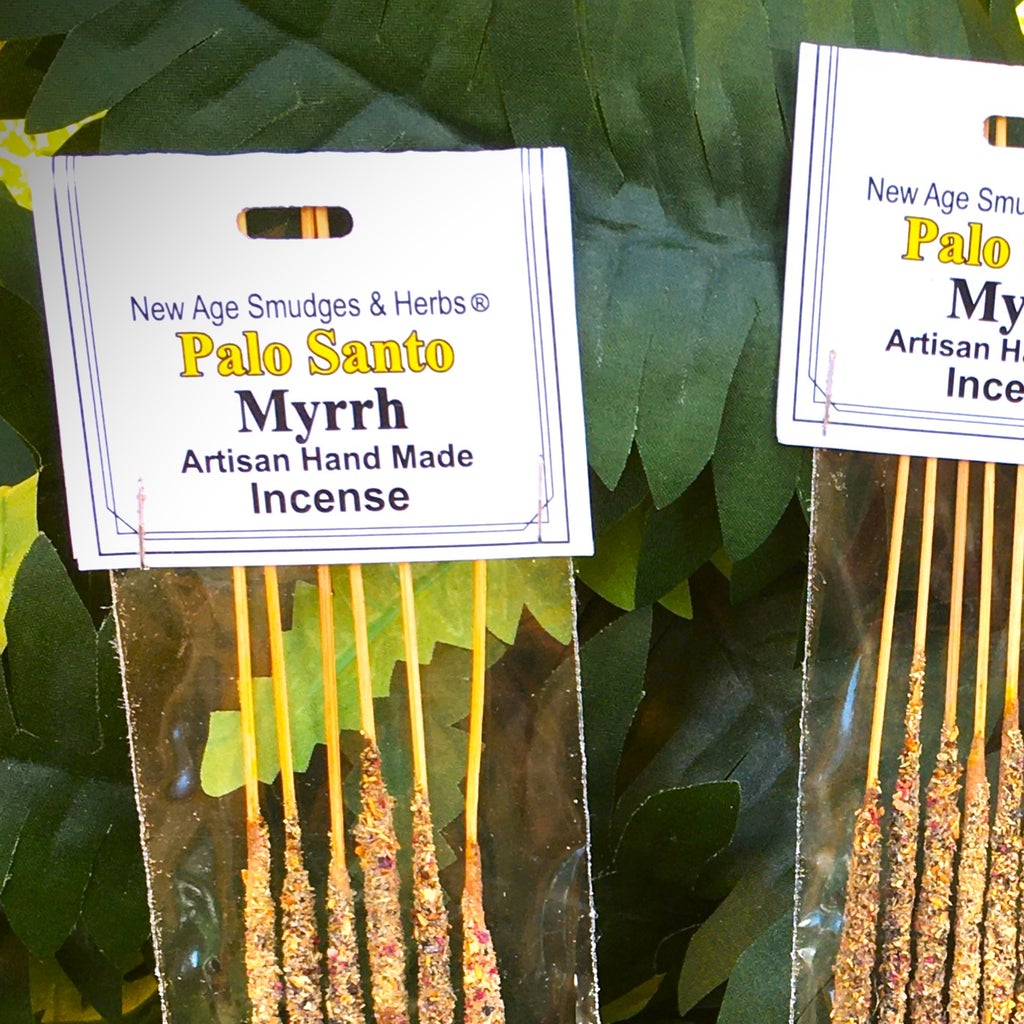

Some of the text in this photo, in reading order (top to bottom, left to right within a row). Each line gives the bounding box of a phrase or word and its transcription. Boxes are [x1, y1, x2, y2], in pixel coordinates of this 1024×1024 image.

[867, 176, 919, 205] New
[923, 182, 970, 215] Age
[900, 215, 1012, 270] Palo
[130, 295, 185, 322] New
[192, 294, 239, 327] Age
[247, 292, 361, 325] Smudges
[369, 290, 387, 317] &
[174, 327, 456, 378] Palo Santo
[885, 328, 990, 361] Artisan
[233, 386, 409, 445] Myrrh
[181, 443, 474, 474] Artisan Hand Made
[250, 482, 410, 514] Incense
